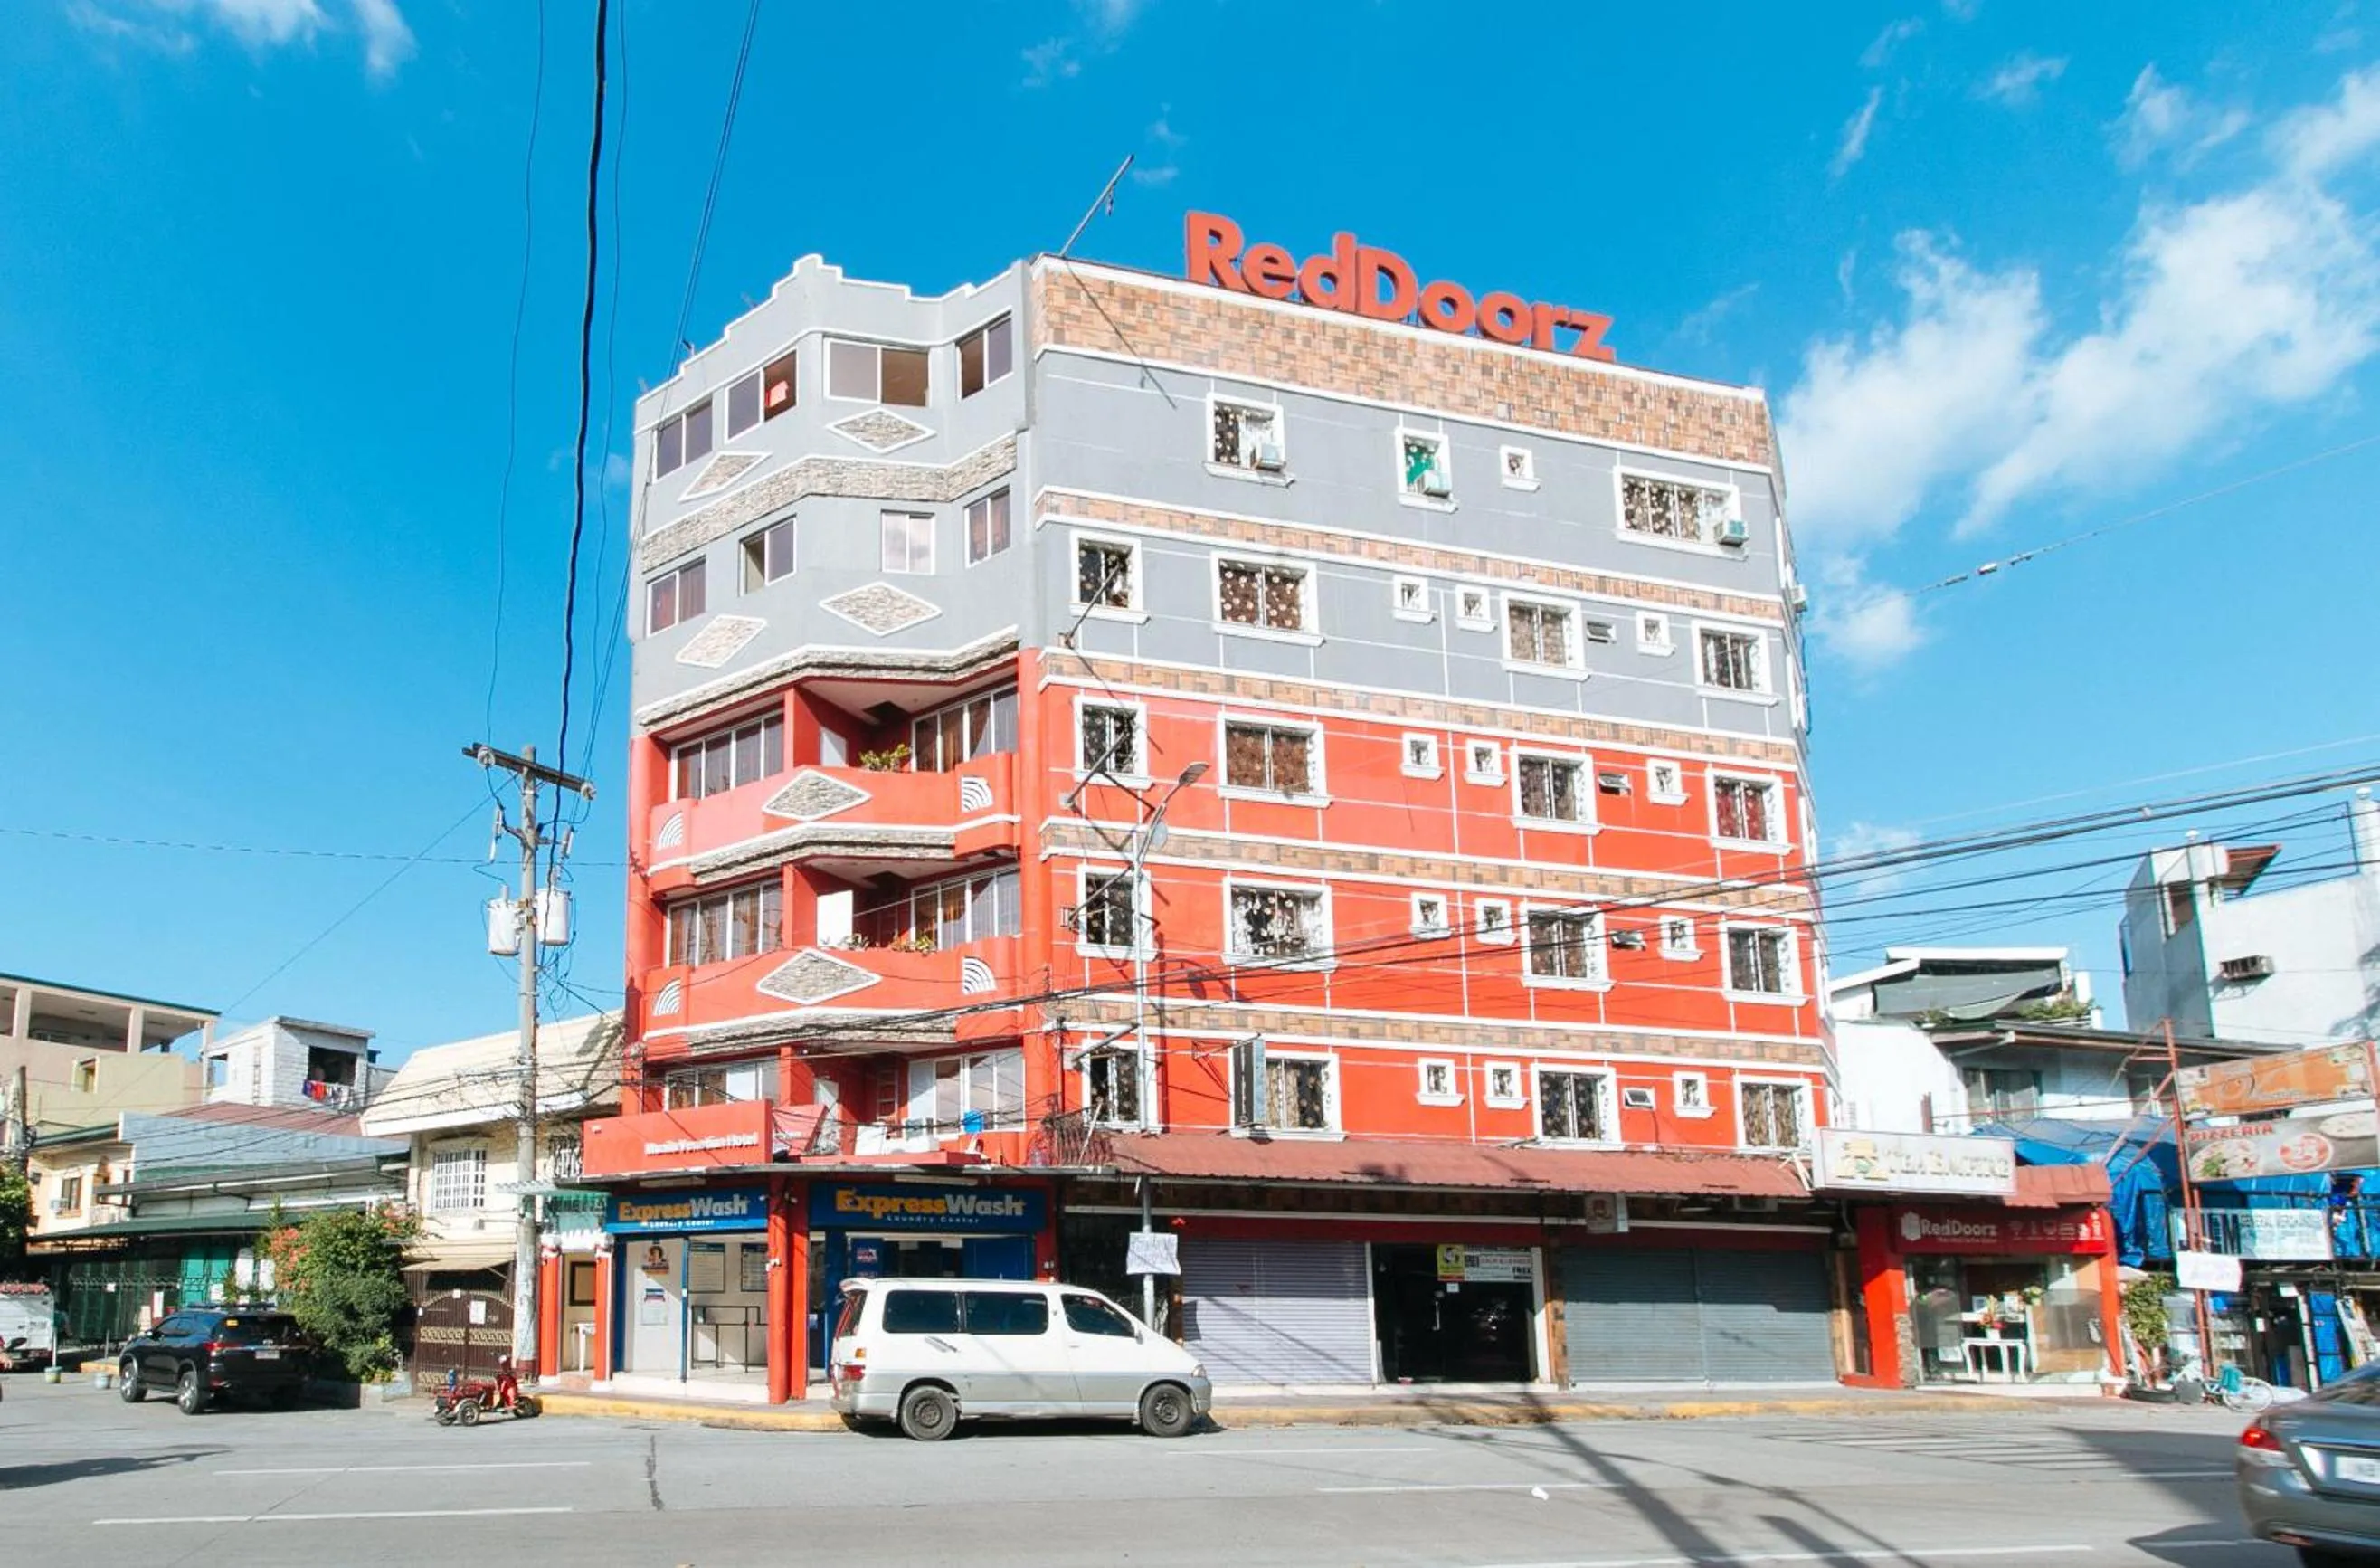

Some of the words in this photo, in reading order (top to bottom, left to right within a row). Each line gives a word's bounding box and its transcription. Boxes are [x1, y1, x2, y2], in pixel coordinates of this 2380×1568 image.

[1186, 210, 1616, 361] RedDoorz
[2189, 1122, 2273, 1143] PIZZERIA
[618, 1194, 750, 1224] ExpressWash
[835, 1188, 1027, 1219] ExpressWash
[886, 1215, 934, 1223] Laundry
[941, 1216, 980, 1224] Center
[1920, 1219, 1998, 1237] RedDoorz
